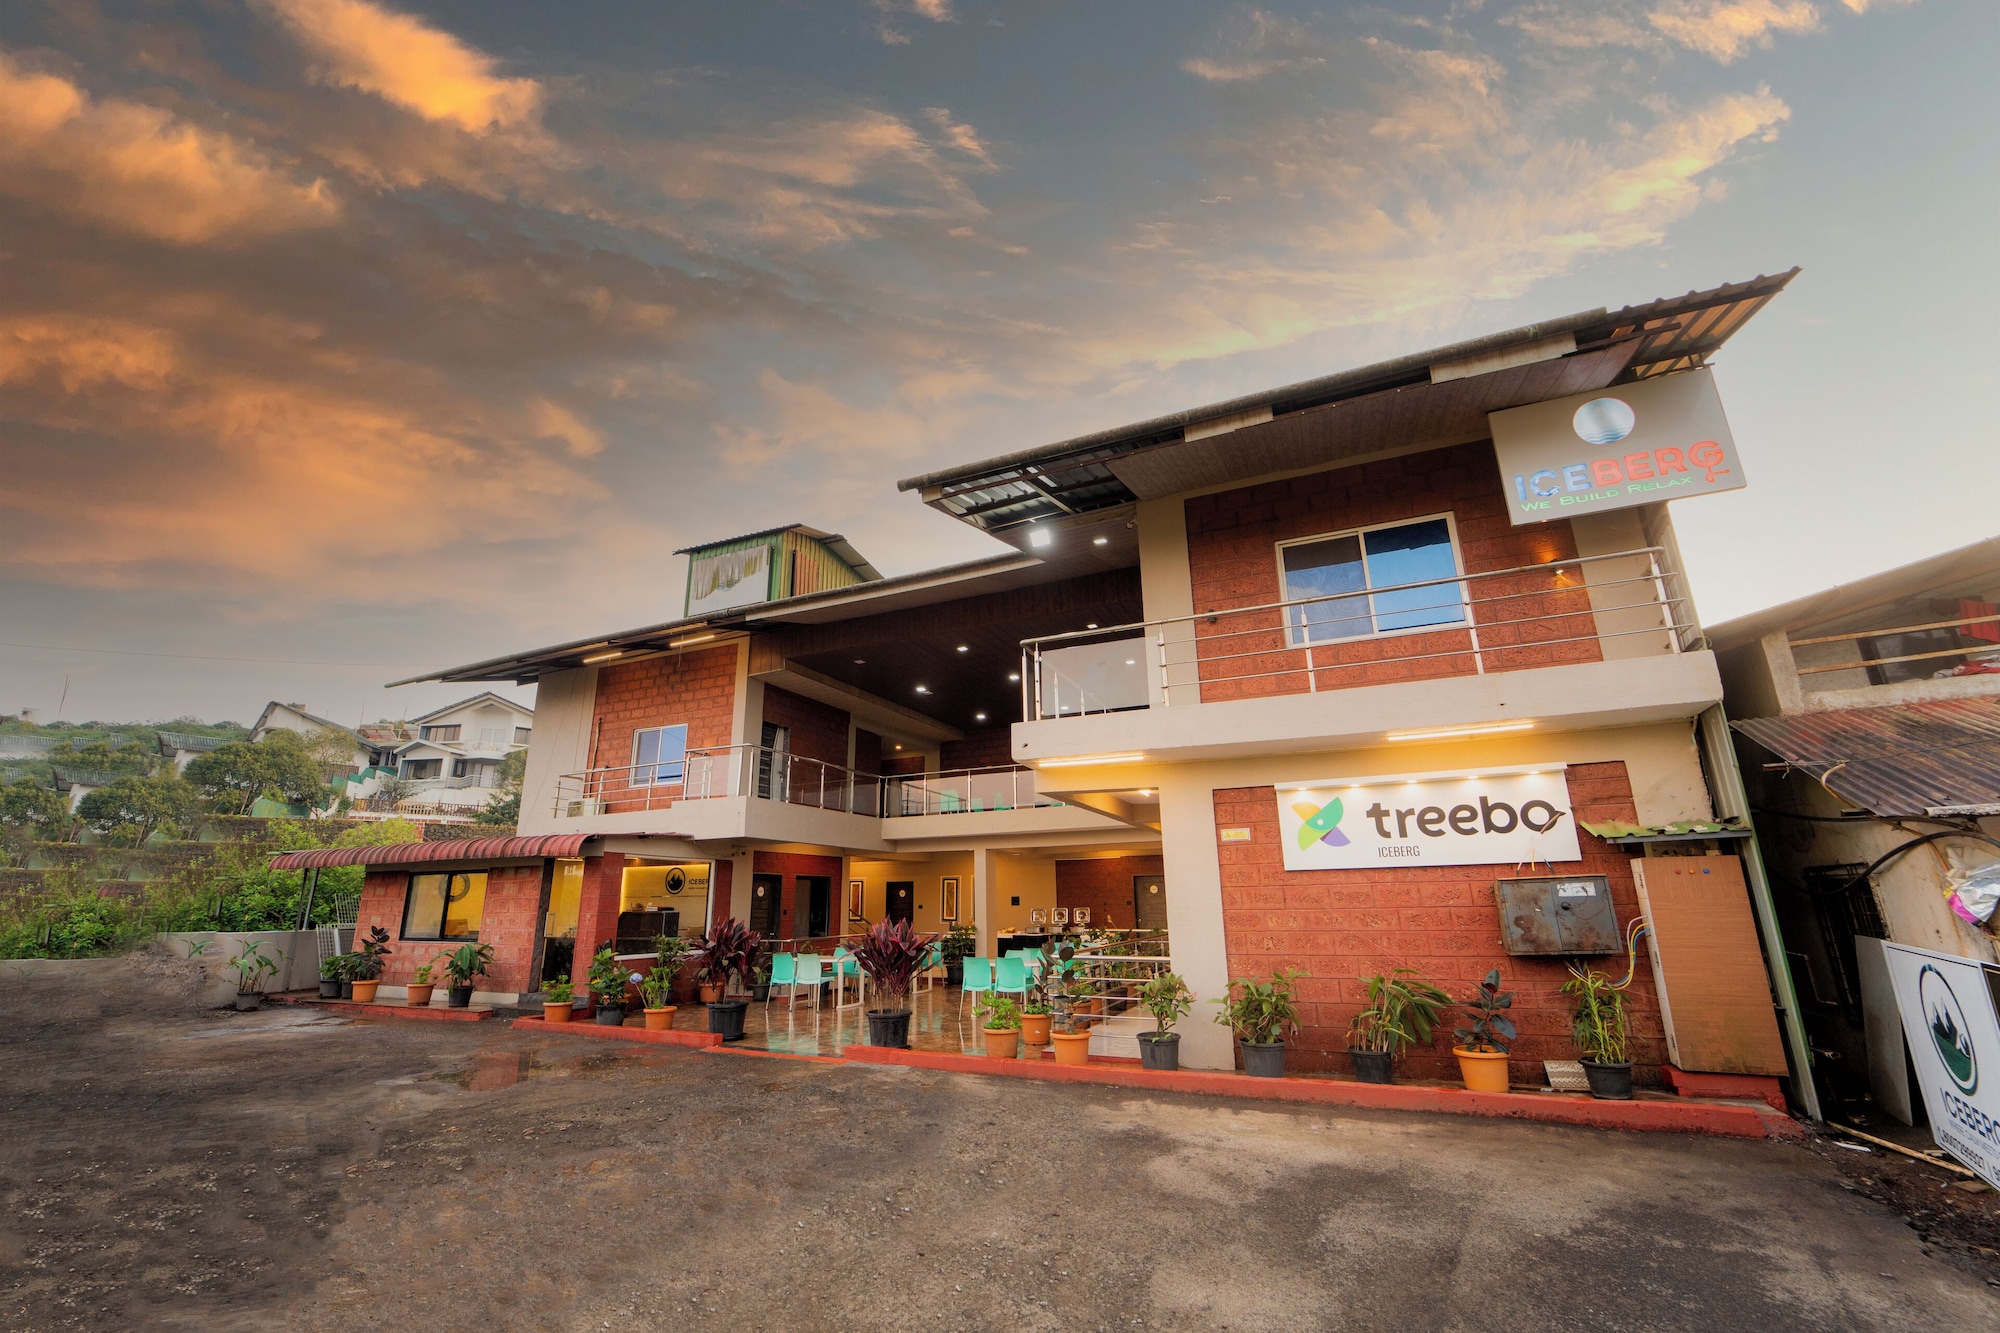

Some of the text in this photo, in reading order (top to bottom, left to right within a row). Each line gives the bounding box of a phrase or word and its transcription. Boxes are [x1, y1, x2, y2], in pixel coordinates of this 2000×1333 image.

[1513, 440, 1730, 500] ICEBERG
[1365, 795, 1566, 839] treebo
[1377, 845, 1420, 859] ICEBERG
